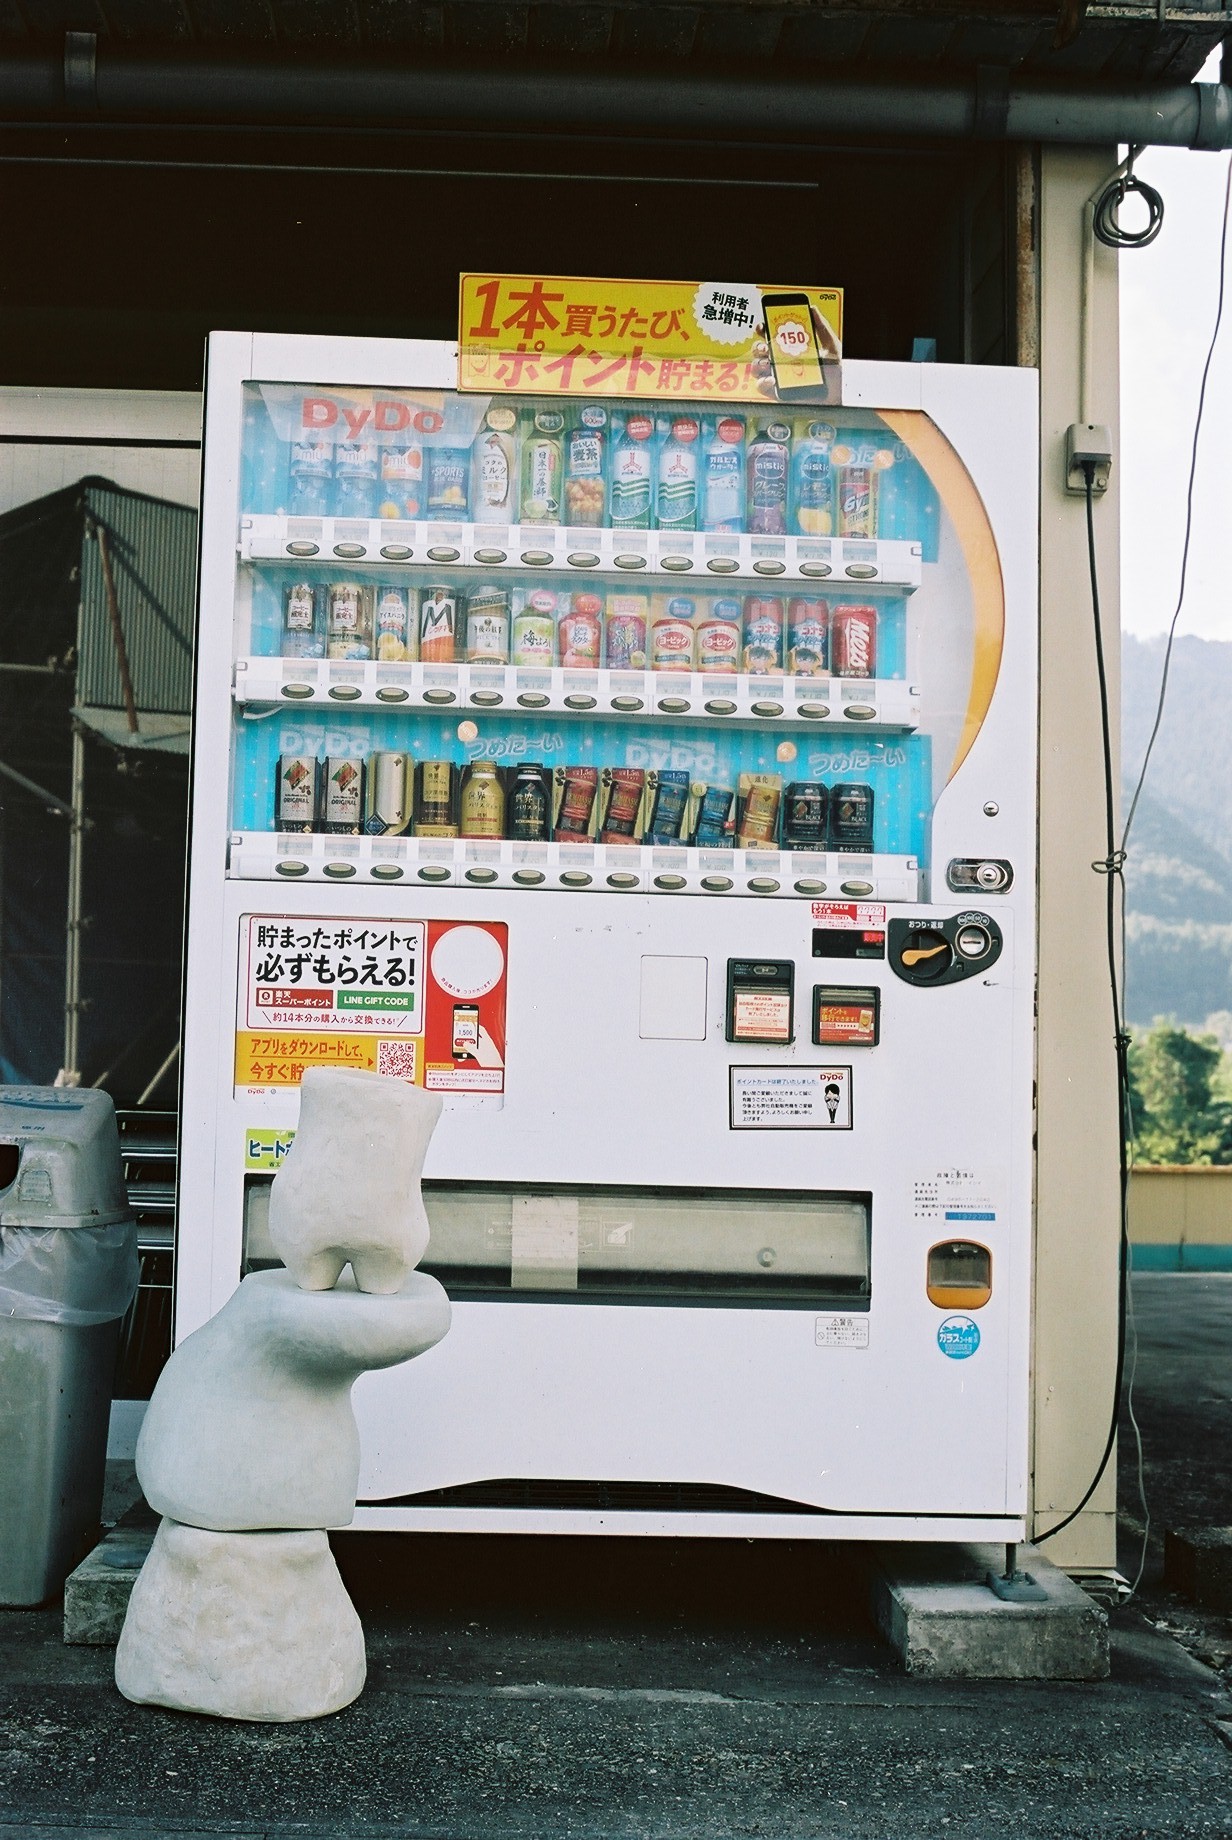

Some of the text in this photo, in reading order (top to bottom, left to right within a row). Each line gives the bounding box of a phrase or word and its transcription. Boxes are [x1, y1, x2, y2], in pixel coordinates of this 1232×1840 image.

[468, 280, 690, 342] 1本買うたび、
[711, 291, 749, 311] 利用者
[701, 304, 755, 329] 急増中!
[780, 331, 806, 345] 150
[493, 339, 754, 393] ポイント貯まる!
[302, 397, 444, 439] DyDo
[908, 920, 944, 929] おつり・返却
[256, 924, 419, 950] 貯まったポイントで
[255, 952, 416, 987] 必ずもらえる!
[275, 990, 291, 998] 楽天
[275, 998, 331, 1007] スーパーポイント
[343, 996, 409, 1006] LINE GIFT CODE
[251, 1037, 363, 1057] アプリをダウンロードして、
[820, 1073, 844, 1081] DyDo
[939, 1333, 960, 1343] ガラス
